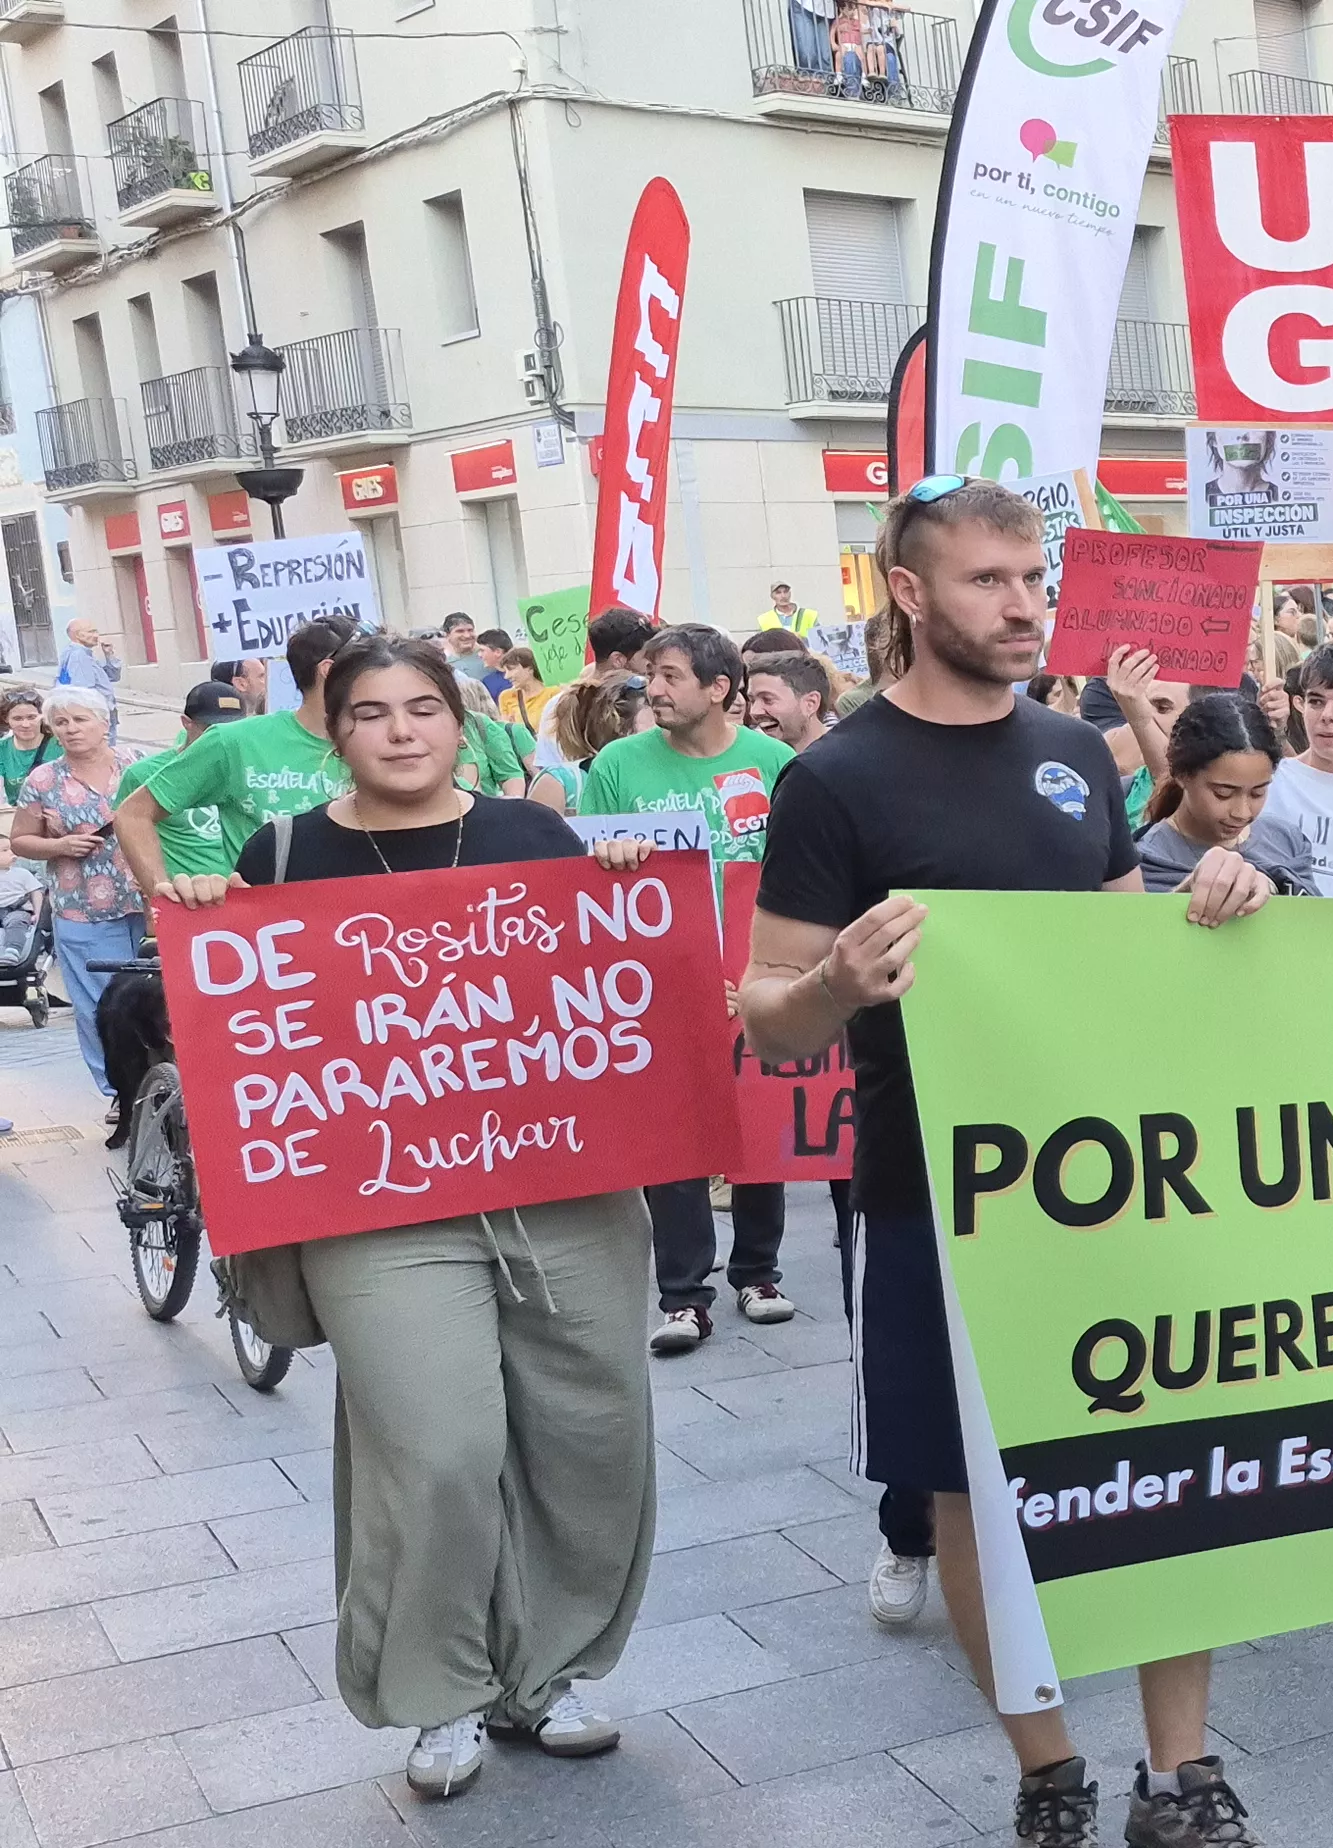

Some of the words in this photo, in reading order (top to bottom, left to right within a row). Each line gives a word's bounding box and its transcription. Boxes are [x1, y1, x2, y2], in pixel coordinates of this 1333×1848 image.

[970, 188, 992, 199] en
[995, 195, 1018, 207] un
[1022, 204, 1063, 219] nuevo
[1067, 212, 1116, 236] tiempo
[973, 162, 1012, 183] por
[1018, 173, 1035, 195] ti,
[1043, 182, 1120, 218] contigo
[1214, 505, 1314, 525] INSPECCIÓN
[1217, 494, 1242, 506] POR
[1244, 493, 1269, 505] UNA
[1072, 537, 1207, 573] PROFESOR
[1222, 526, 1251, 539] ÚTIL
[1254, 526, 1263, 537] Y
[1265, 524, 1305, 537] JUSTA
[227, 539, 365, 591] REPRESIÓN
[1063, 607, 1192, 636] ALUMNADO
[733, 813, 769, 834] CGT
[190, 919, 316, 996] DE
[335, 883, 568, 988] Rositas
[576, 877, 672, 946] NO
[228, 1000, 323, 1055] SE
[551, 959, 653, 1031] NO
[232, 1020, 653, 1129] PARAREMOS
[242, 1128, 326, 1183] DE
[359, 1109, 585, 1196] Luchar
[953, 1110, 1213, 1237] POR
[1210, 1447, 1260, 1497] la
